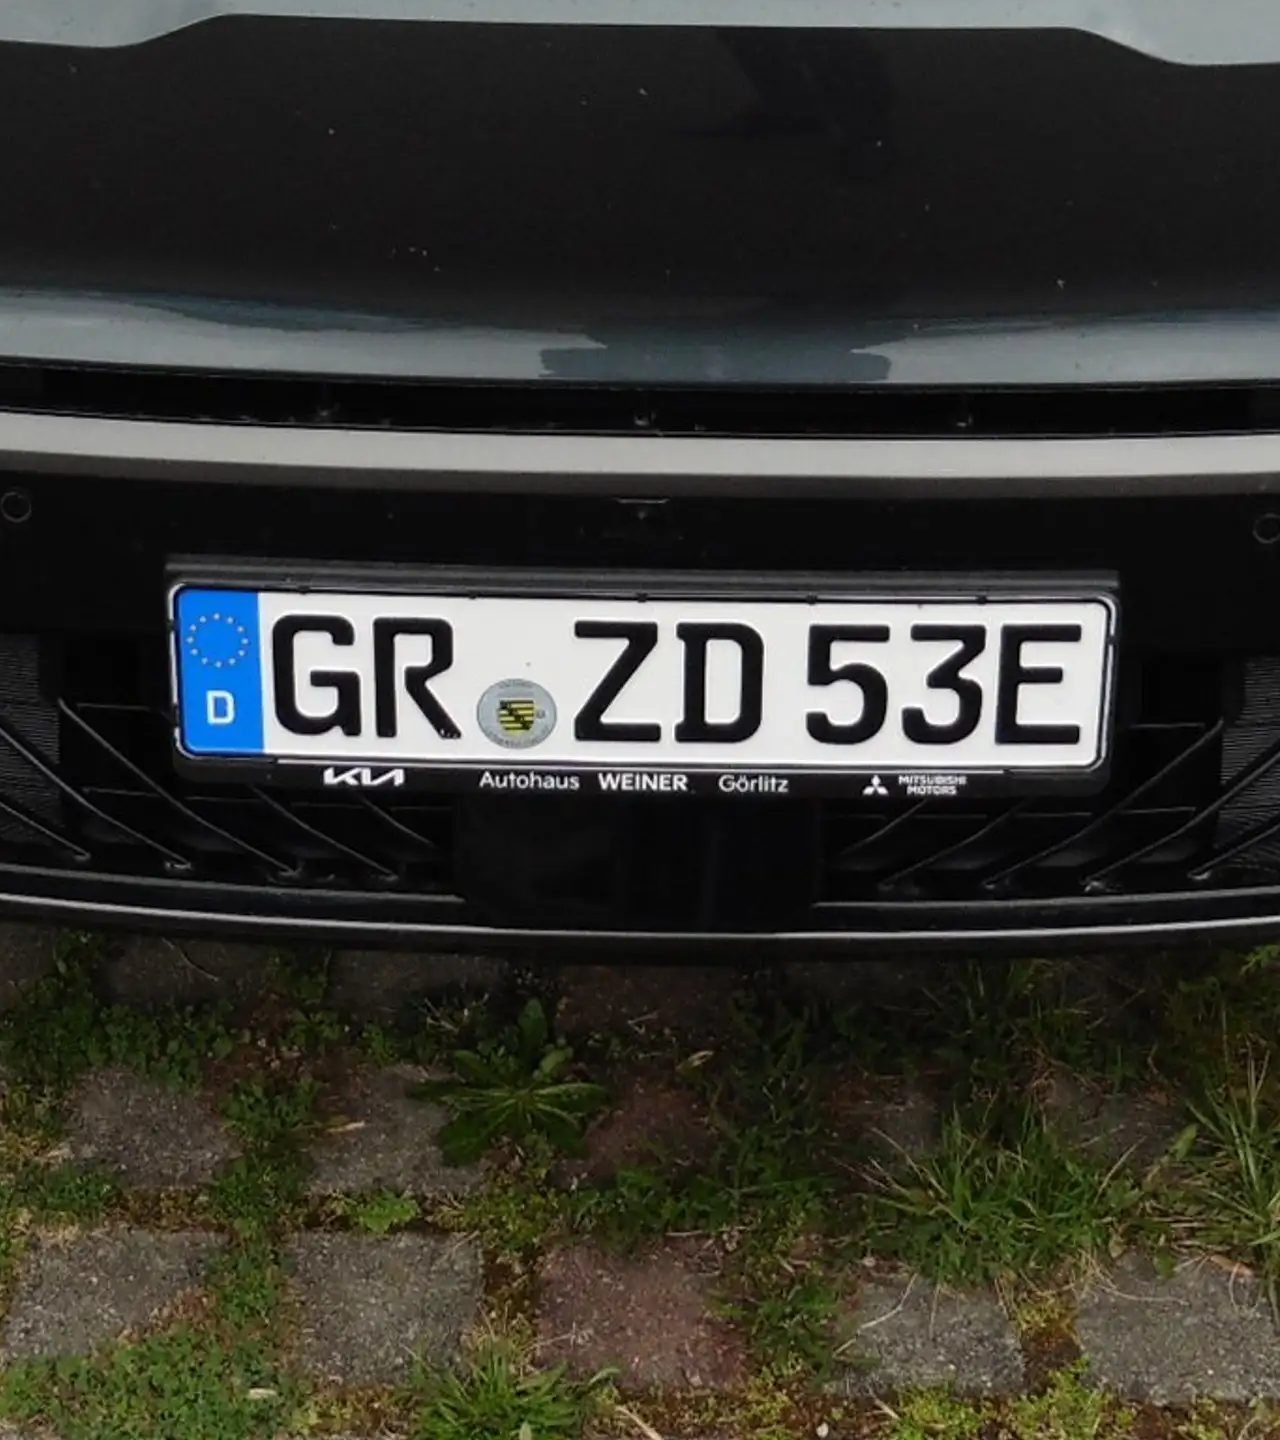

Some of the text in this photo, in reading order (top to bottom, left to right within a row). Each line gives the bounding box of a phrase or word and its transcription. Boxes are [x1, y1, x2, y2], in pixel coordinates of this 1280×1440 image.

[272, 614, 1082, 745] GR ZD 53E
[206, 690, 235, 725] D
[479, 770, 789, 793] Autohaus WEINER Görlitz
